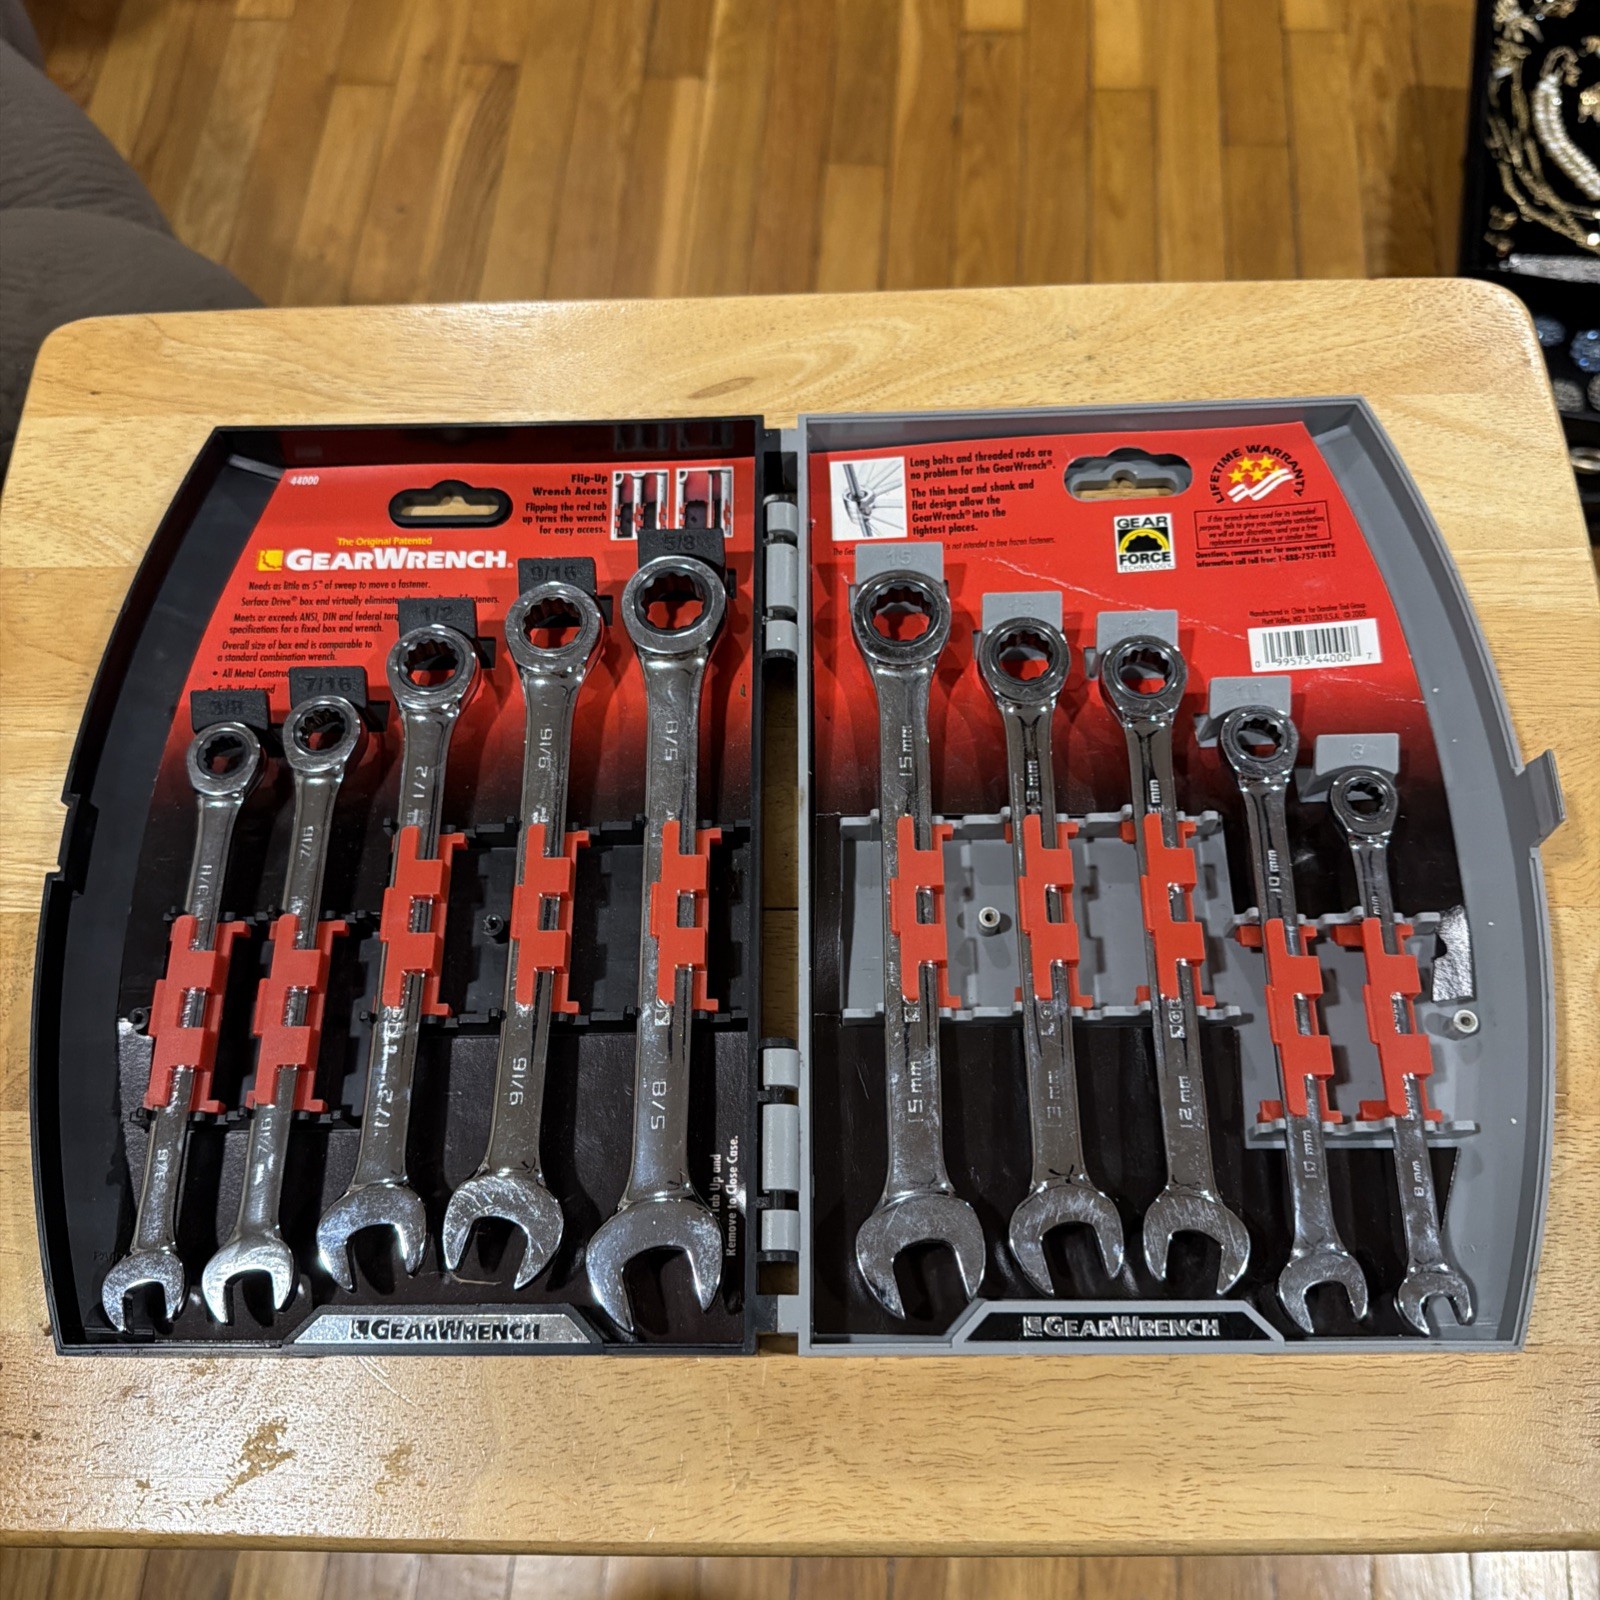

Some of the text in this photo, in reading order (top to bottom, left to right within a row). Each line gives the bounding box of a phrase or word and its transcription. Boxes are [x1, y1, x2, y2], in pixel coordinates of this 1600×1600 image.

[909, 448, 1052, 469] Long bolts and threaded rods are
[290, 475, 320, 486] 44000
[571, 474, 608, 485] Flip-Up
[910, 472, 921, 480] no
[923, 468, 958, 482] problem
[960, 466, 973, 476] for
[976, 464, 990, 474] the
[1209, 445, 1305, 504] LIFETIME WARRANTY
[532, 486, 608, 496] Wrench Access
[910, 478, 1034, 498] The thin head and shank and
[525, 501, 607, 514] Flipping the red tab
[911, 495, 1001, 511] flat design allow the
[522, 513, 606, 526] up turns the wrench
[972, 510, 989, 518] into
[992, 507, 1006, 517] the
[1116, 516, 1168, 529] GEAR
[539, 525, 551, 535] for
[554, 527, 574, 536] easy
[912, 523, 978, 538] tightest places.
[338, 536, 433, 548] The Original Patented
[663, 535, 695, 551] 5/8
[888, 549, 912, 567] 15
[1118, 551, 1171, 565] FORCE
[530, 565, 577, 581] 9/16
[249, 581, 271, 590] Needs
[283, 581, 299, 590] little
[324, 580, 333, 590] of
[334, 582, 357, 591] sweep
[359, 581, 367, 589] to
[398, 579, 431, 589] fastener.
[241, 597, 269, 606] Surface
[300, 597, 313, 605] box
[316, 596, 330, 605] end
[332, 595, 362, 606] virtually
[234, 614, 256, 622] Meets
[268, 612, 298, 621] exceeds
[323, 612, 337, 621] DIN
[339, 611, 353, 621] and
[355, 611, 381, 620] federal
[383, 613, 399, 622] torq
[421, 605, 453, 621] 1/2
[229, 625, 278, 635] specifications
[281, 624, 291, 633] for
[301, 624, 320, 633] fixed
[322, 624, 336, 633] box
[339, 623, 353, 632] end
[355, 622, 384, 632] wrench.
[222, 638, 372, 651] Overall size of box end is comparable to
[224, 652, 258, 661] standard
[259, 652, 306, 661] combination
[308, 651, 337, 660] wrench.
[222, 668, 233, 677] All
[234, 668, 256, 677] Metal
[302, 676, 352, 692] 7/16
[538, 728, 553, 769] 9/16
[664, 720, 679, 762] 5/8
[411, 765, 429, 799] 1/2
[509, 1056, 527, 1106] 9/16
[650, 1080, 667, 1130] 5/8
[709, 1153, 722, 1173] and
[709, 1176, 724, 1191] Up
[725, 1135, 739, 1257] Remove to Close Case.
[370, 1319, 540, 1341] GEARWRENCH
[1043, 1315, 1220, 1337] GEARWRENCH
